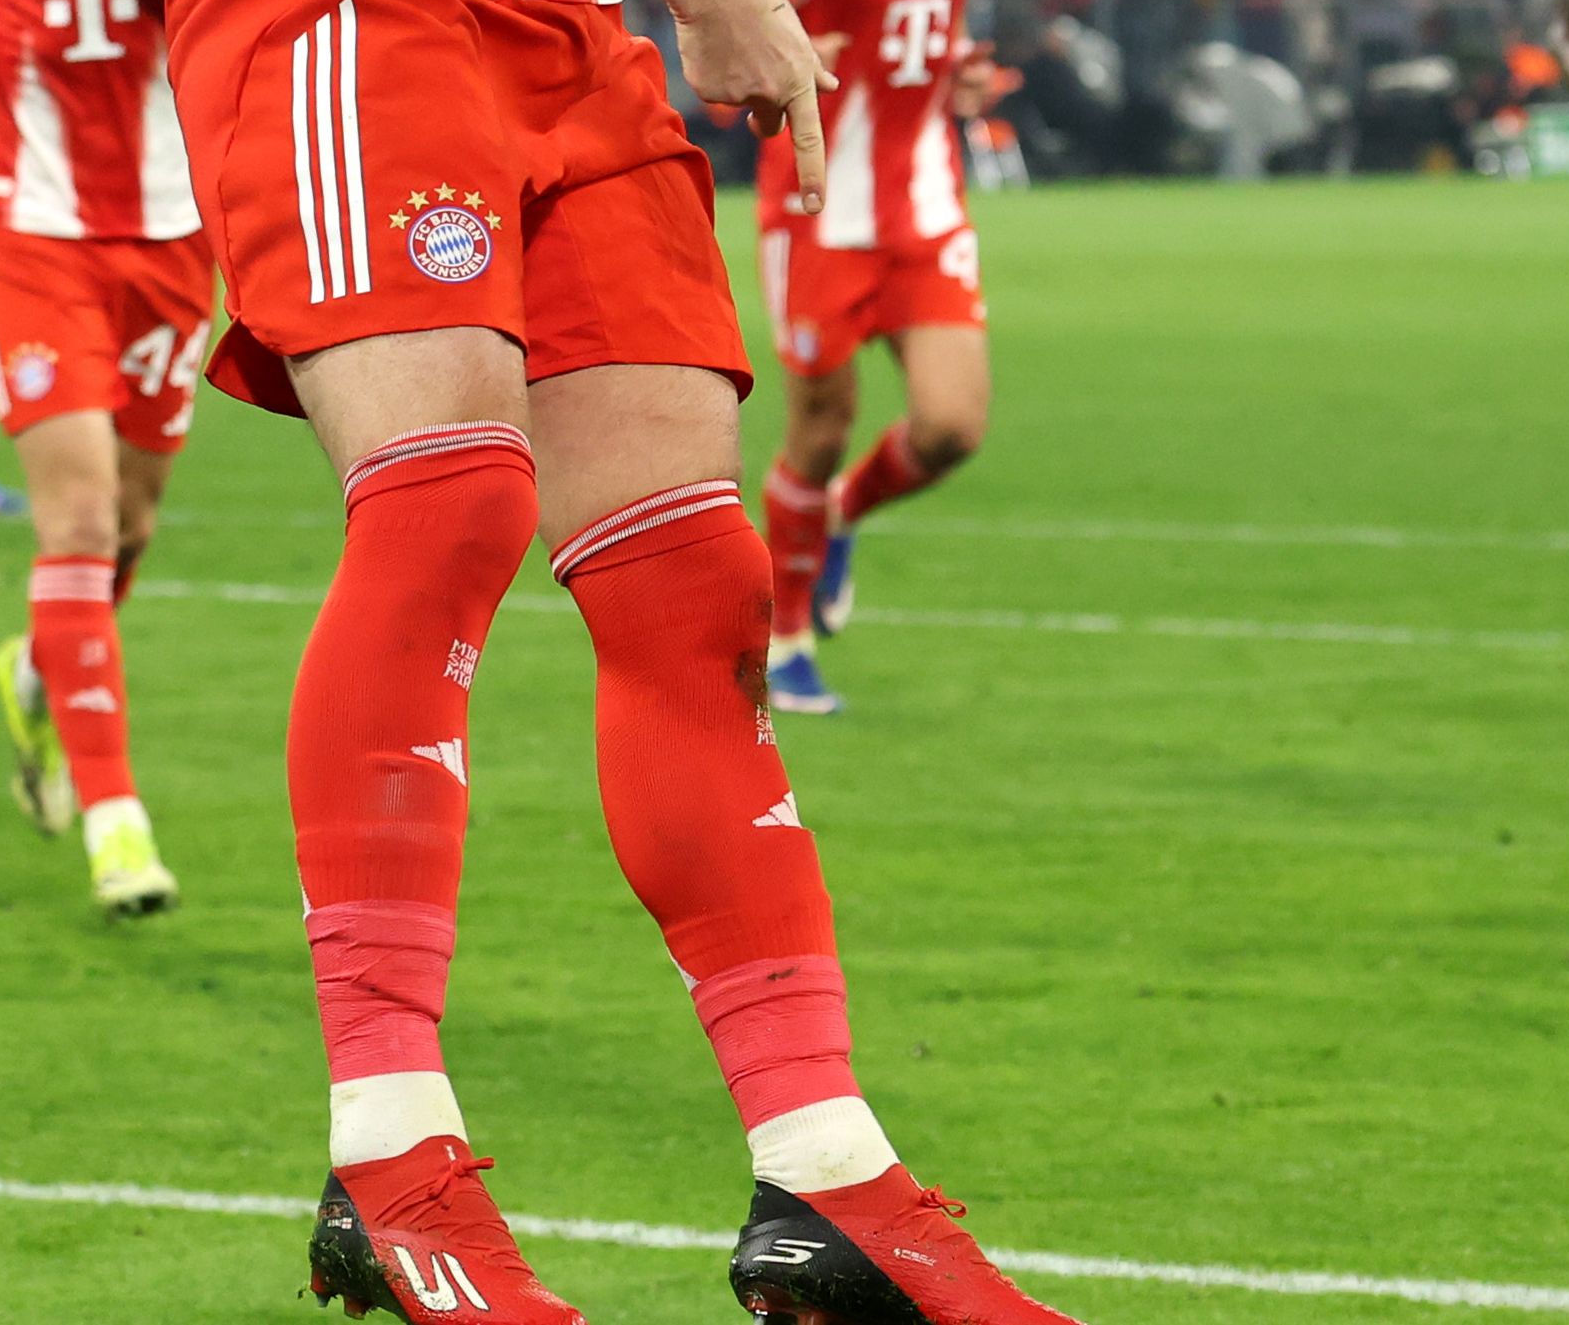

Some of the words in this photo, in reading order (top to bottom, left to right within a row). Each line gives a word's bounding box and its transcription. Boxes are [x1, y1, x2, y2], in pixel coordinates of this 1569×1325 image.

[415, 223, 431, 242] FC
[430, 212, 484, 242] BAYERN
[450, 638, 479, 664] MIA
[443, 664, 472, 692] MIA
